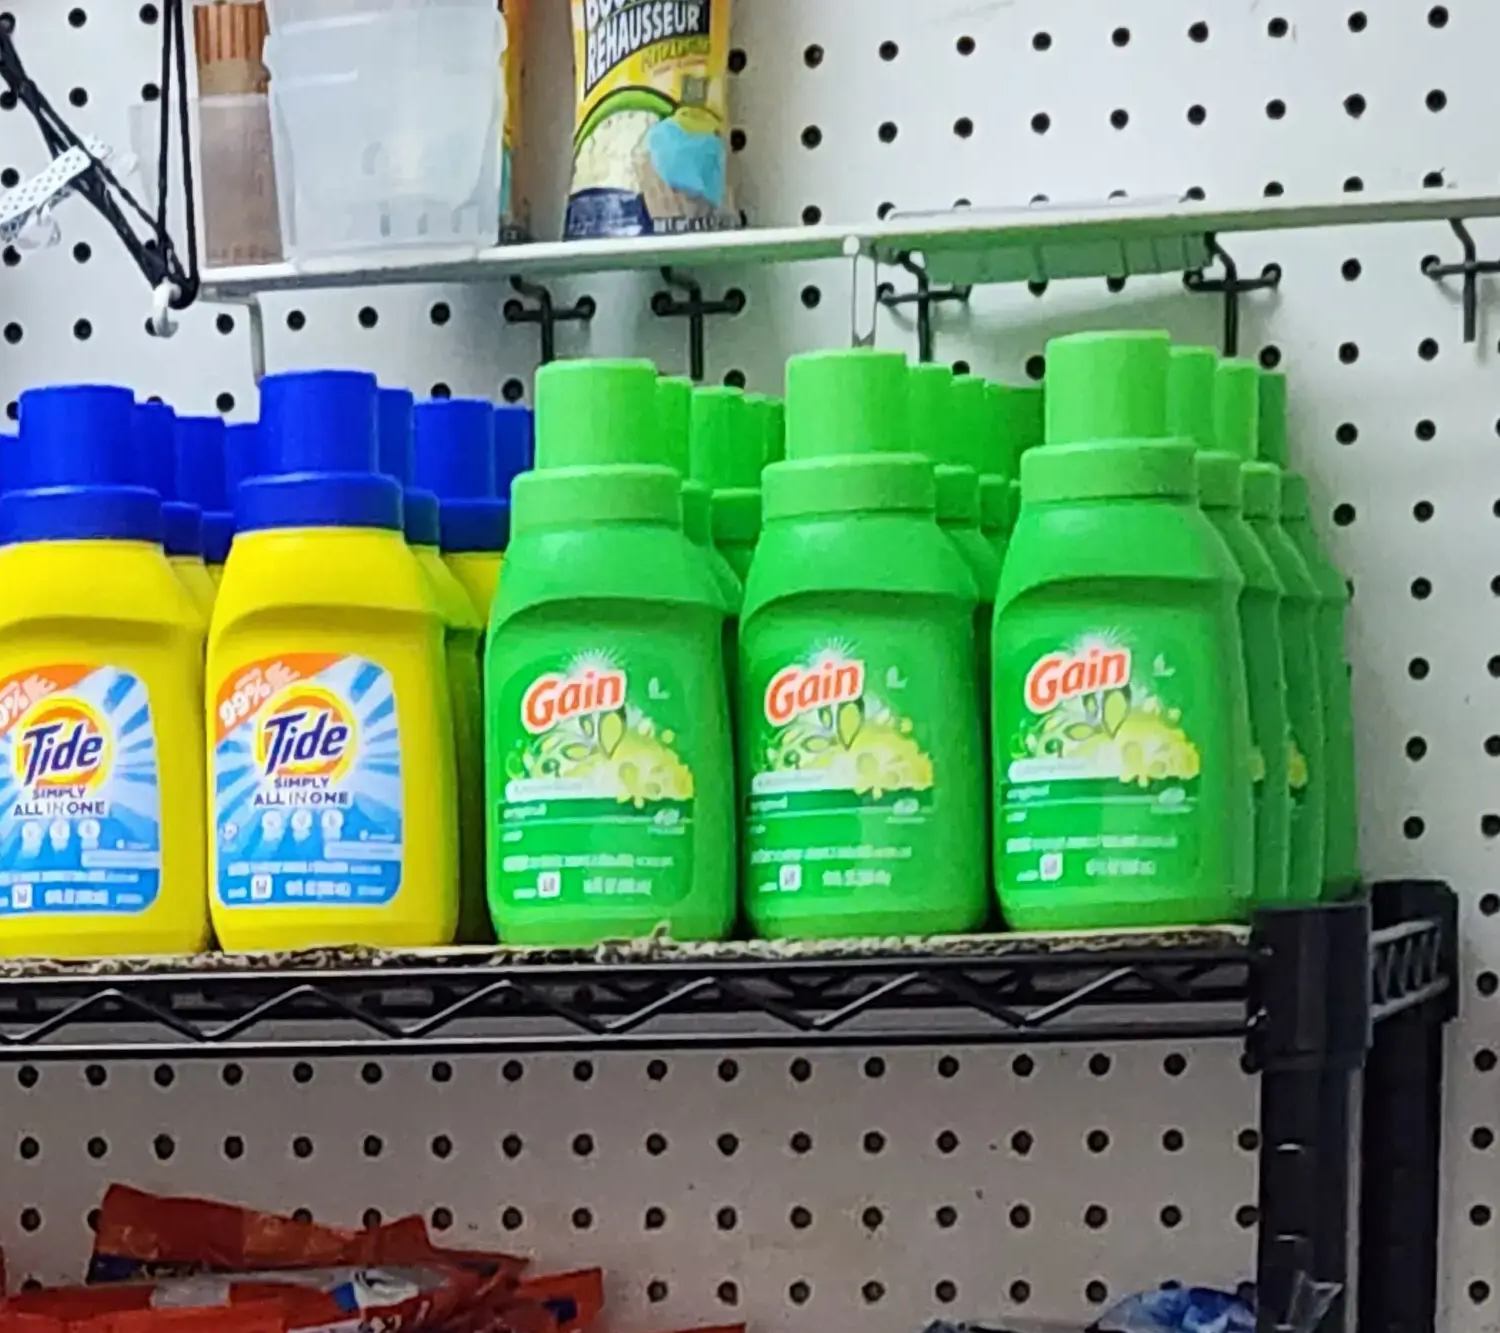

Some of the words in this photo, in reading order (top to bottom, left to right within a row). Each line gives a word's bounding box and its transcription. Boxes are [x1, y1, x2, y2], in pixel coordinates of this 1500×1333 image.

[586, 2, 700, 91] REHAUSSEUR
[525, 670, 622, 728] Gain
[768, 661, 858, 720] Gain
[1029, 649, 1126, 707] Gain
[23, 723, 104, 786] Tide
[264, 712, 349, 776] Tide
[13, 801, 43, 816] ALL
[66, 801, 106, 815] ONE
[31, 787, 86, 800] SIMPLY
[253, 791, 285, 805] ALL
[288, 791, 307, 804] IN
[309, 791, 350, 805] ONE
[274, 777, 329, 789] SIMPLY
